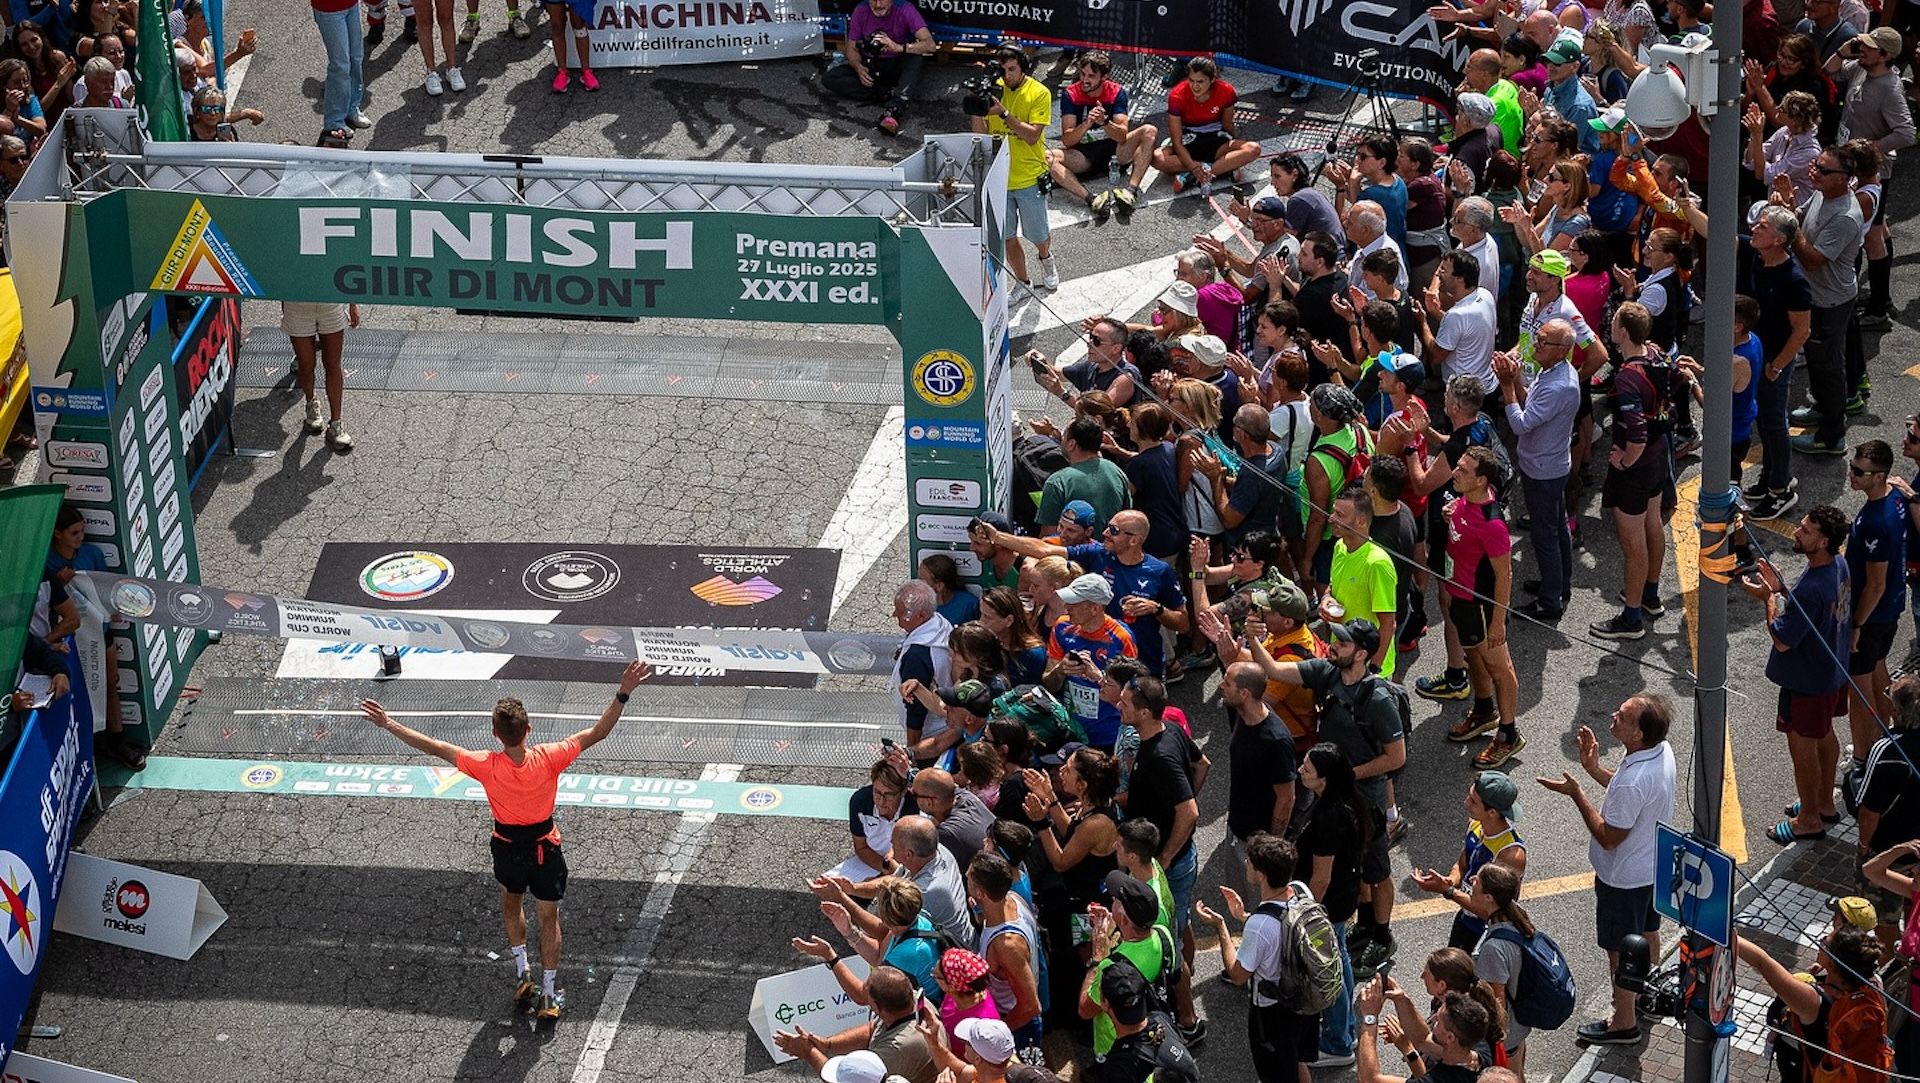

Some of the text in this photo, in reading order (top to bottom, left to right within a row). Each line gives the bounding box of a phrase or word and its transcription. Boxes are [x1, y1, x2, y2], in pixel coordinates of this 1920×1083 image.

[596, 2, 773, 30] ANCHINA
[592, 32, 770, 53] www.edilfranchina.it
[1333, 52, 1453, 97] EVOUTIONARY
[162, 211, 203, 284] GIIR DI MONT
[299, 206, 693, 269] FINISH
[736, 233, 876, 258] Premana
[738, 259, 877, 279] 27 Luglio 2025
[334, 265, 665, 308] GIIR DI MONT
[740, 278, 879, 304] XXXI ed.
[703, 558, 784, 566] ATHLETICS
[714, 565, 768, 573] WORLD
[325, 766, 410, 780] 32km
[587, 776, 622, 791] DI
[629, 779, 697, 794] GIIR
[1670, 845, 1714, 910] P
[104, 918, 147, 935] melesi
[797, 999, 825, 1015] BCC
[836, 1011, 856, 1020] Banca
